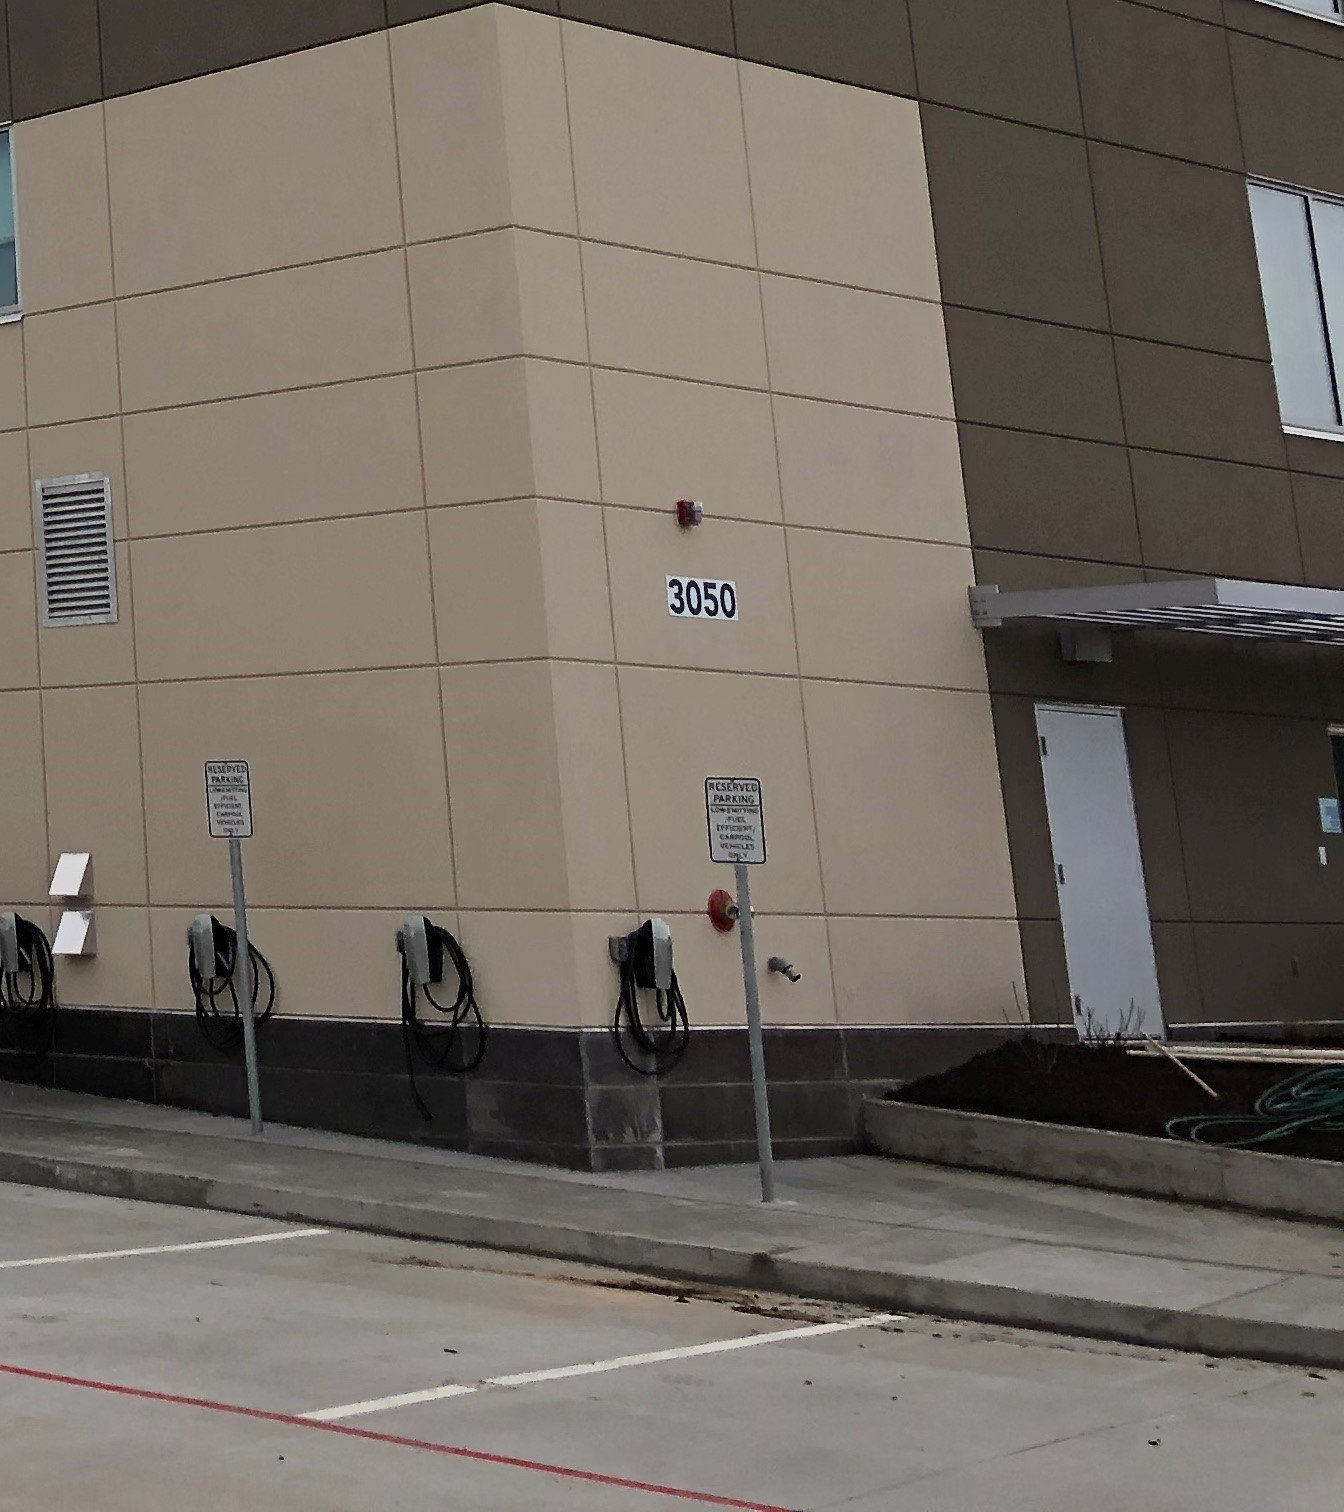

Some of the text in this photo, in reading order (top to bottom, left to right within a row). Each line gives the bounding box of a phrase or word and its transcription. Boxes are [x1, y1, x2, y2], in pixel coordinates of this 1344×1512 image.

[668, 578, 737, 619] 3050
[208, 765, 247, 774] RESERVED
[211, 775, 244, 783] PARKING
[708, 782, 758, 792] RESERVED
[713, 794, 755, 804] PARKING
